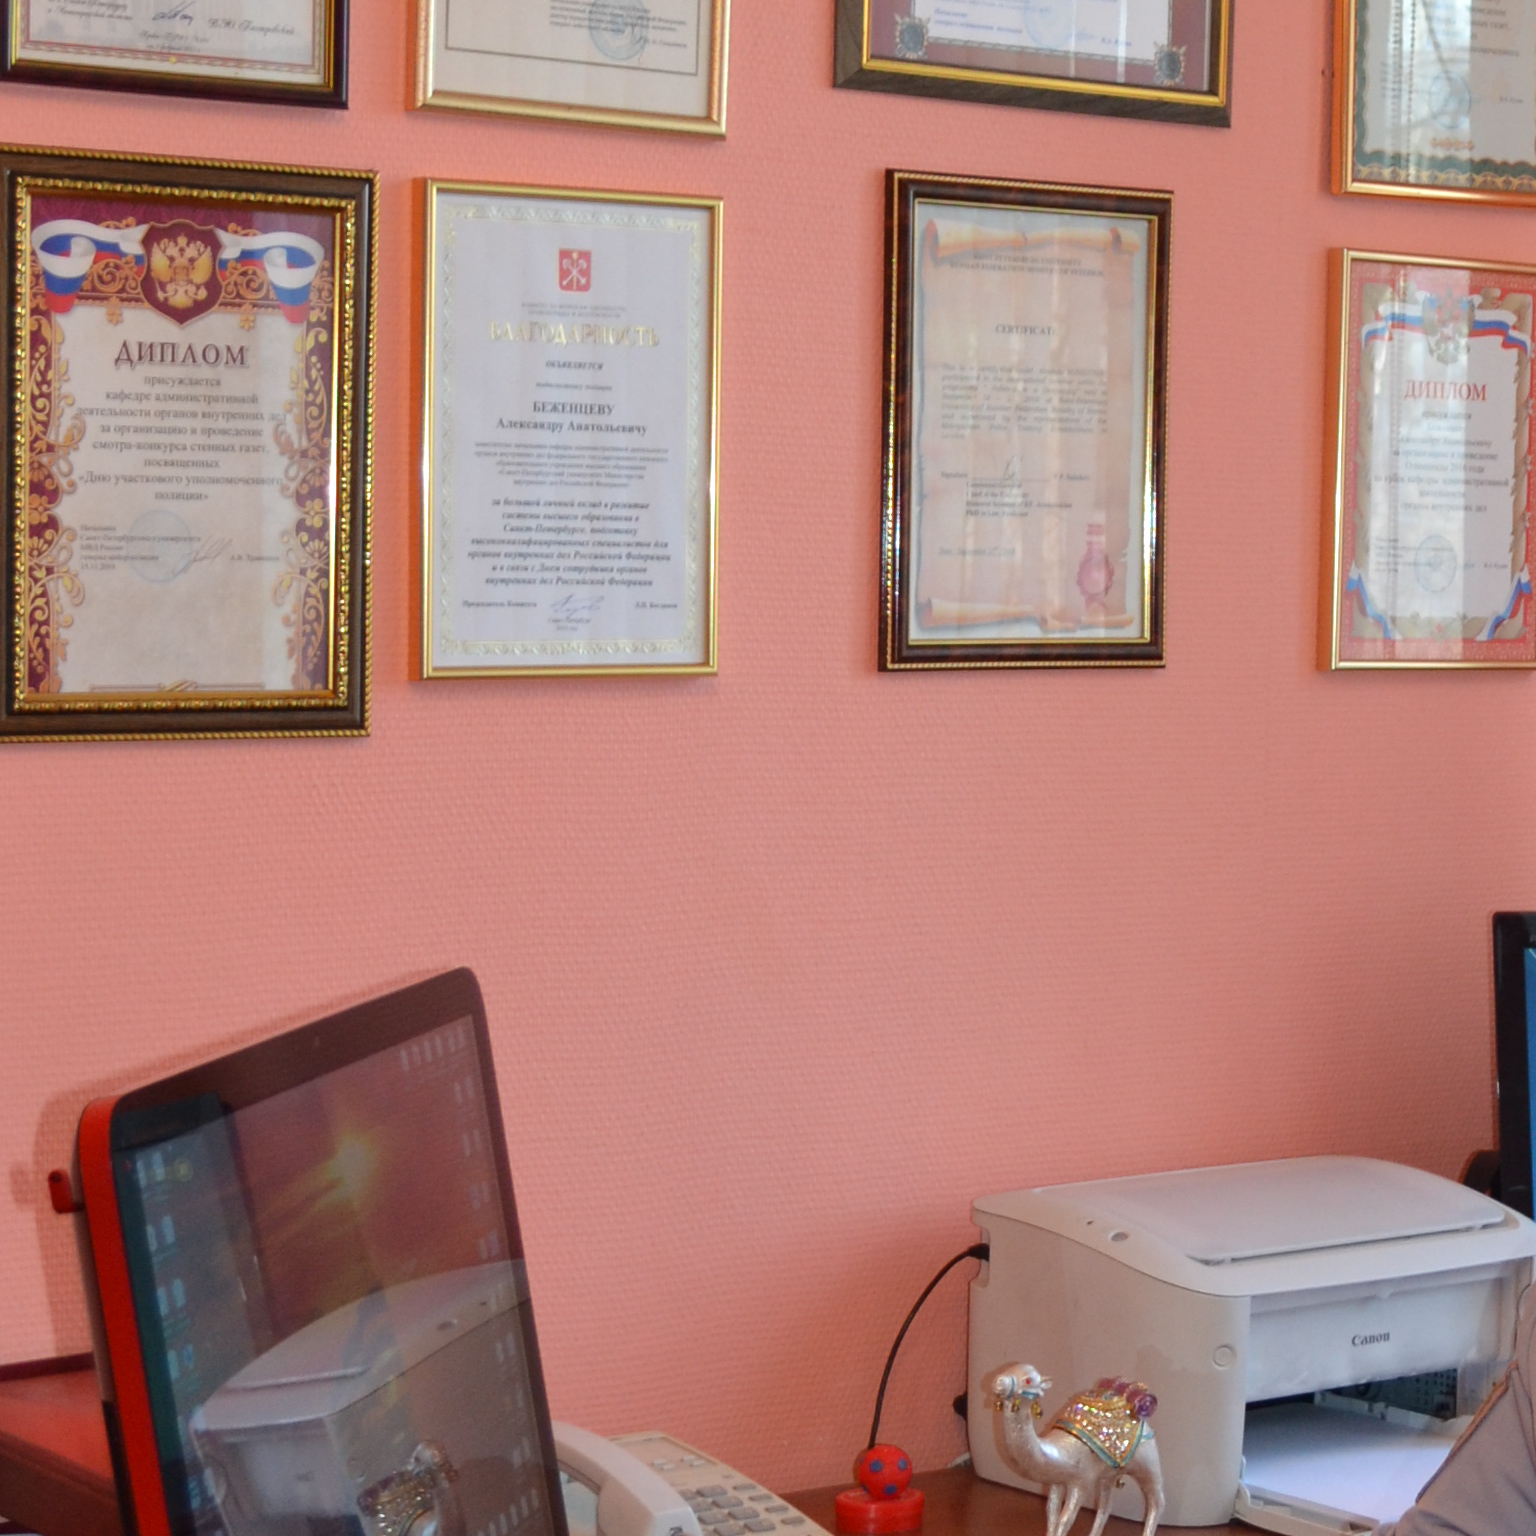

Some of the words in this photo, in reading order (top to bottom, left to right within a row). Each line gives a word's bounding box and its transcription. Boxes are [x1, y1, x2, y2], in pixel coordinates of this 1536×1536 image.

[488, 319, 660, 351] БЛАГОДАРНОСТЬ
[113, 339, 248, 374] ДИПЛОМ
[545, 359, 603, 370] ОБЪЯВЛЯЕТСЯ
[143, 374, 221, 388] присуждается
[105, 388, 151, 402] кафедре
[154, 390, 258, 406] административной
[1403, 379, 1487, 403] ДИПЛОМ
[75, 405, 151, 418] деятельности
[154, 407, 197, 420] органов
[201, 409, 264, 422] внутренних
[532, 400, 615, 416] БЕЖЕНЦЕВУ
[100, 422, 110, 433] за
[113, 423, 187, 436] организацию
[190, 425, 196, 436] и
[199, 426, 263, 439] проведение
[495, 417, 563, 434] Александру
[567, 419, 647, 436] Анатольевичу
[92, 438, 187, 452] смотра-конкурса
[190, 442, 235, 454] стенных
[143, 457, 221, 470] посвященных
[78, 470, 111, 483] «Дню
[114, 472, 182, 485] участкового
[185, 474, 283, 488] уполномоченного
[154, 489, 209, 501] полиции»
[1351, 1331, 1391, 1347] Canon
